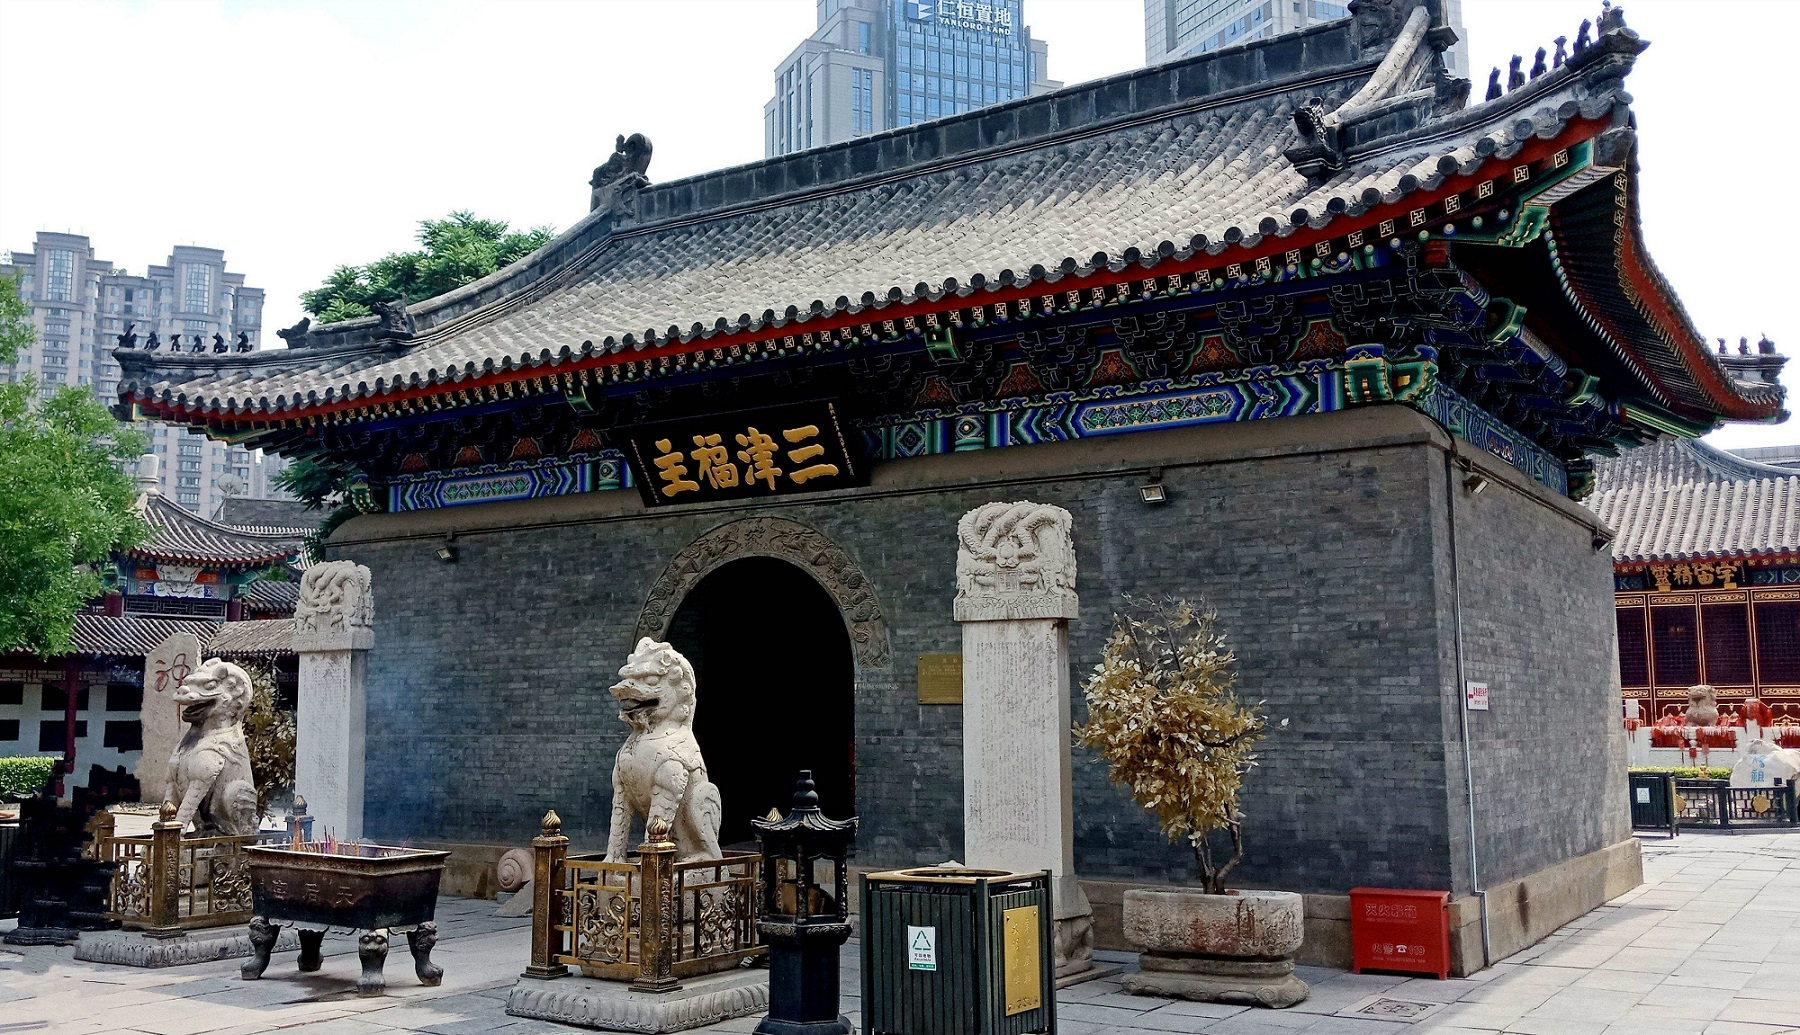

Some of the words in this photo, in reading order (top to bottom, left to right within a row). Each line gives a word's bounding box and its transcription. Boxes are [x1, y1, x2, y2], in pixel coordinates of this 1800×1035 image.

[937, 0, 1012, 27] 仁恒置地
[938, 17, 983, 31] YANLORD
[986, 25, 1011, 35] LAND
[1365, 903, 1417, 918] 灭火器箱
[1408, 945, 1426, 956] 119
